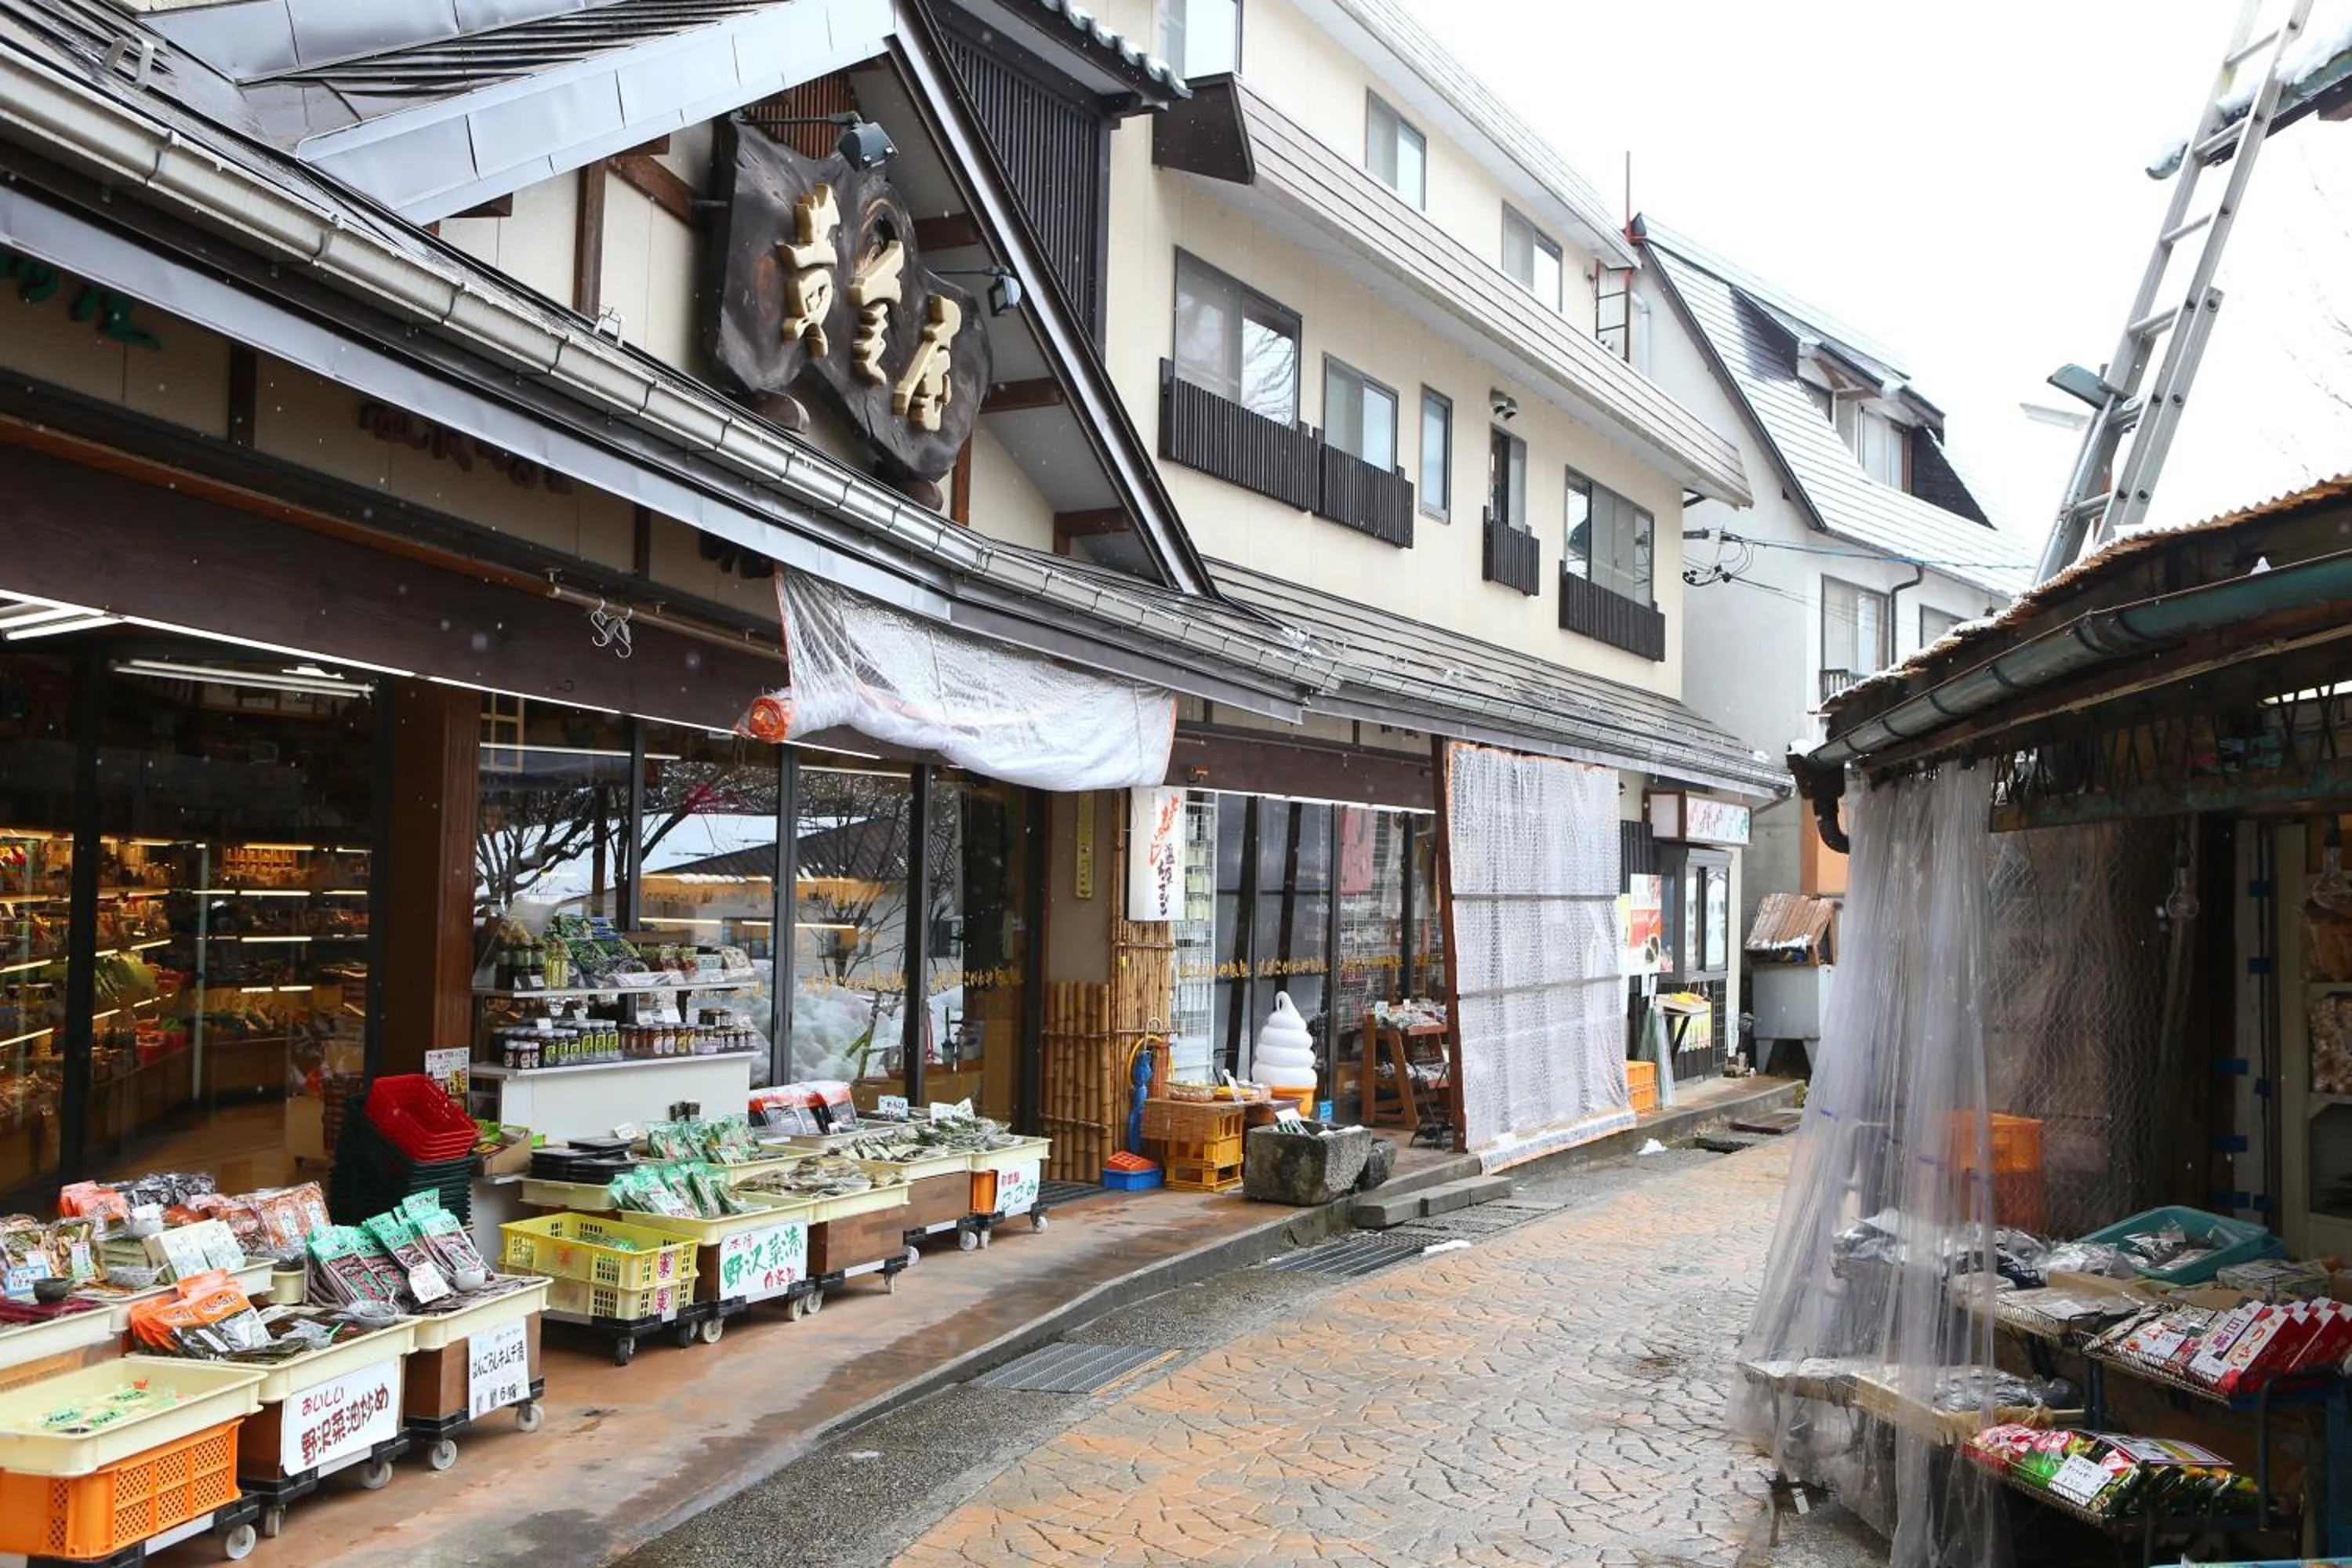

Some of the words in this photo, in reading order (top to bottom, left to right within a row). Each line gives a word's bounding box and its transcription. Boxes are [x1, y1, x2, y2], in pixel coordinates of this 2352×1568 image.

[1002, 1179, 1036, 1210] こごみ
[723, 1225, 804, 1289] 野沢菜漬
[301, 1385, 344, 1416] おいしい
[301, 1383, 390, 1466] 野沢菜油炒め
